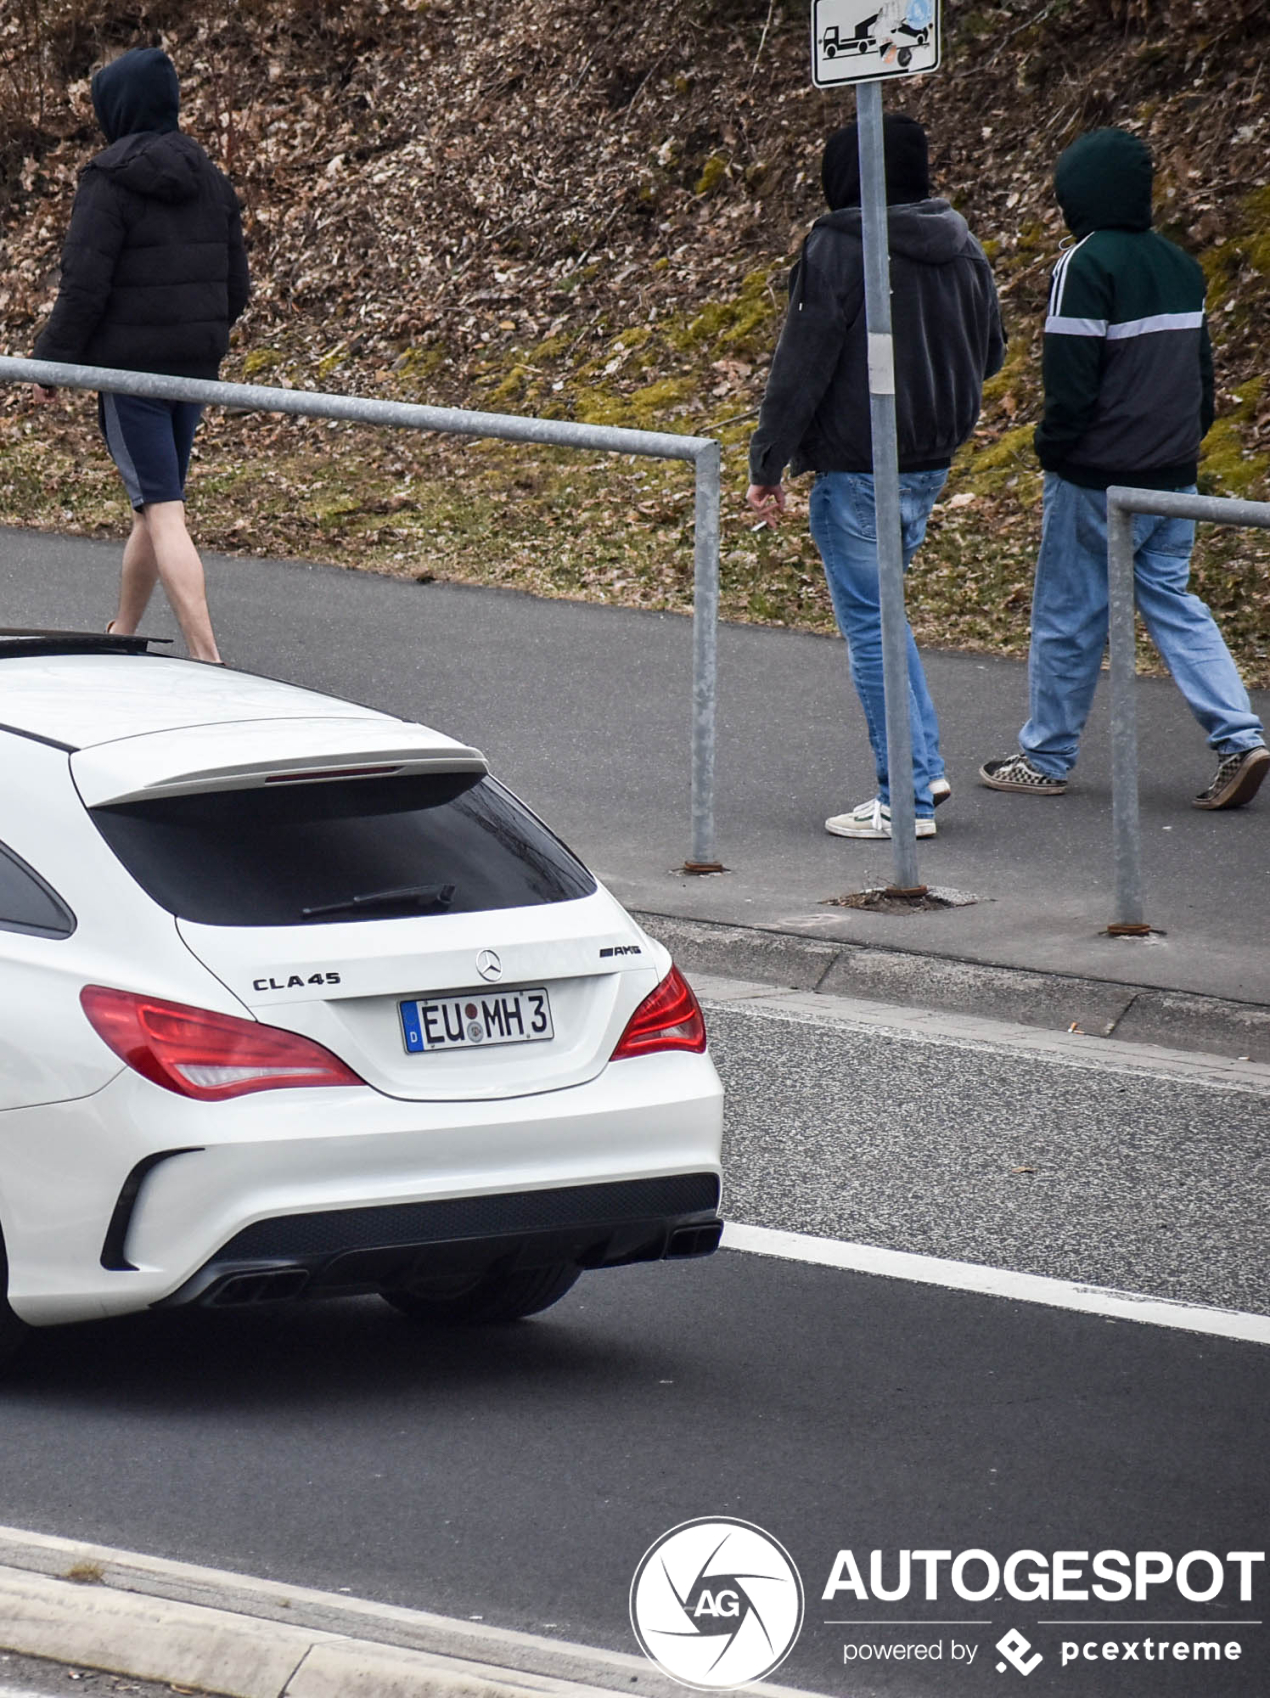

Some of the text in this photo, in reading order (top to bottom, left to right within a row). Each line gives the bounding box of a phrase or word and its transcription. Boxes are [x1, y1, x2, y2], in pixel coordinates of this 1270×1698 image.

[614, 945, 641, 956] AMG
[410, 995, 547, 1044] D EU MH 3
